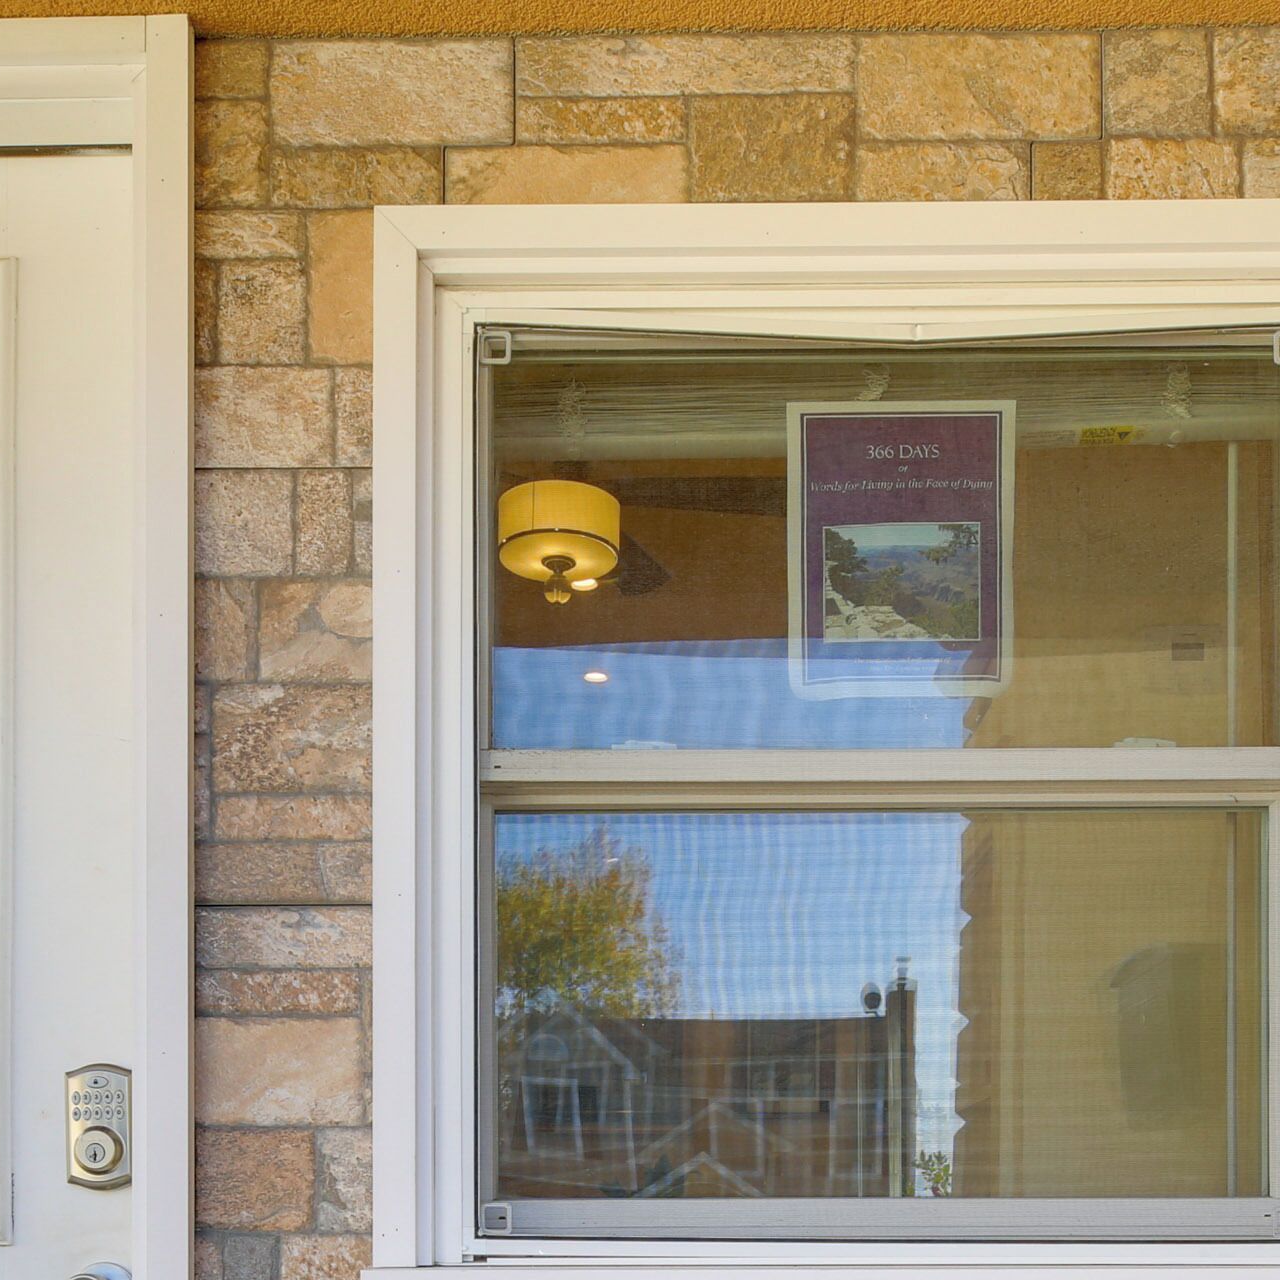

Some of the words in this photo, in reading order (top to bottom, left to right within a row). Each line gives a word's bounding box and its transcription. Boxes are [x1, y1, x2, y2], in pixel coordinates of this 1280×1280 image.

[866, 445, 894, 459] 366
[899, 444, 940, 459] DAYS
[811, 481, 841, 492] Words
[842, 480, 859, 493] for
[862, 480, 893, 491] Living
[895, 478, 905, 488] in
[908, 478, 924, 488] the
[926, 479, 949, 488] Face
[951, 479, 961, 490] of
[963, 479, 993, 491] Dying
